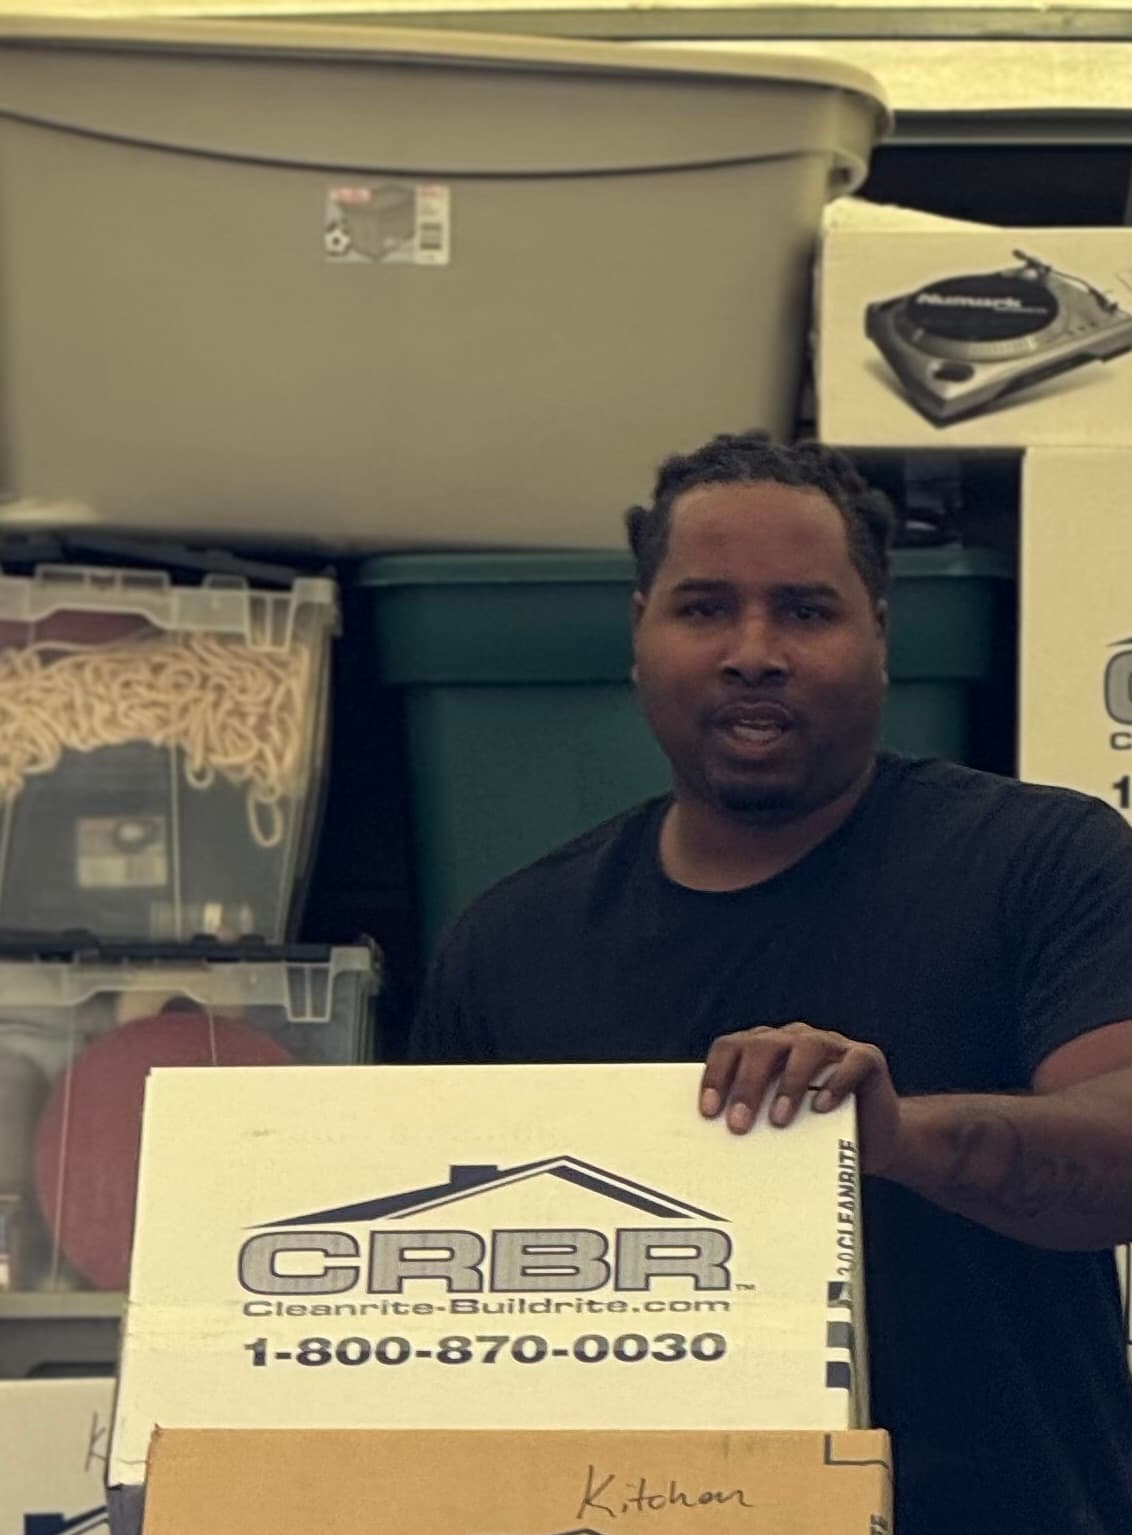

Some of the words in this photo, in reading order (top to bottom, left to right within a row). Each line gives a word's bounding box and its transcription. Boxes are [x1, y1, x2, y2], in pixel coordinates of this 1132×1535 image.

[238, 1228, 733, 1295] CRBR
[242, 1299, 732, 1318] Cleanrite-Buildrite.com
[244, 1332, 728, 1368] 1-800-870-0030
